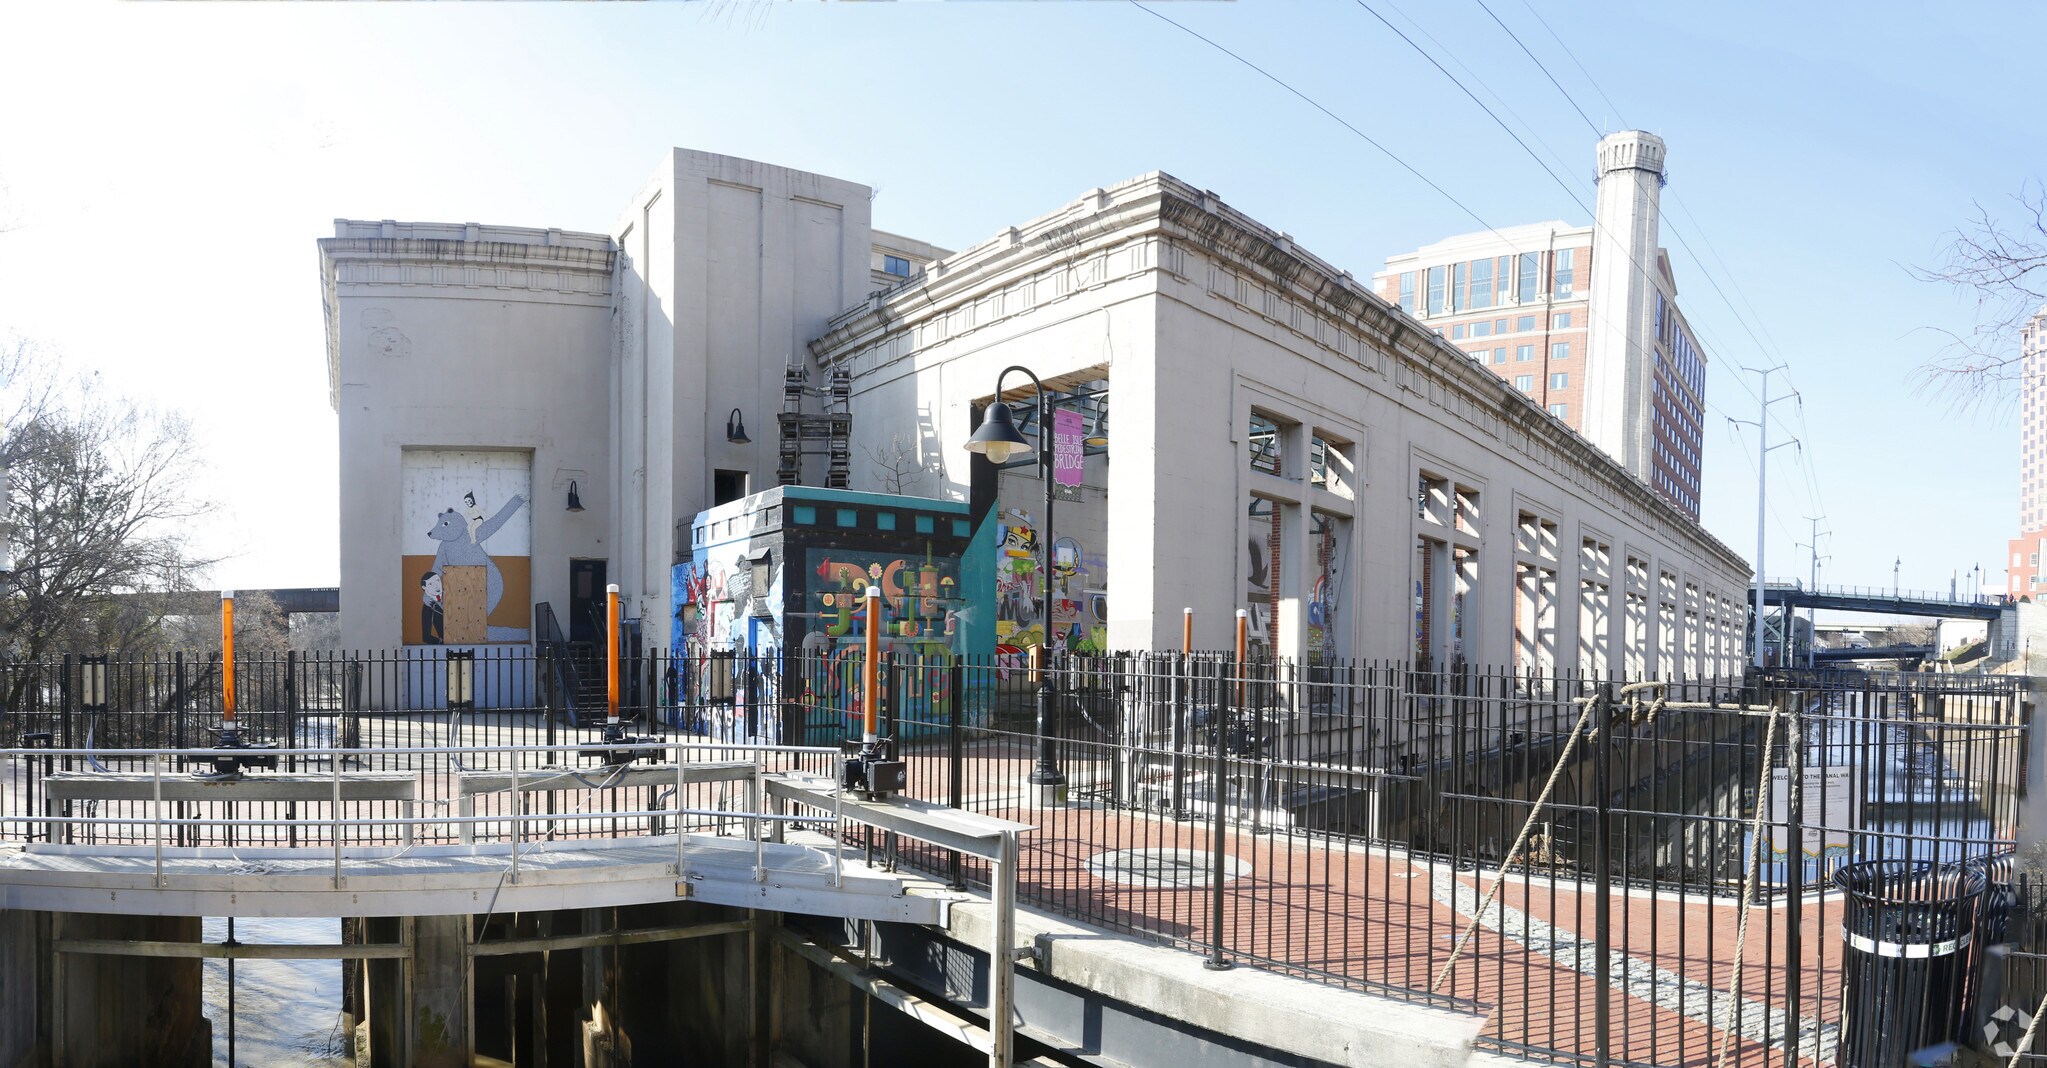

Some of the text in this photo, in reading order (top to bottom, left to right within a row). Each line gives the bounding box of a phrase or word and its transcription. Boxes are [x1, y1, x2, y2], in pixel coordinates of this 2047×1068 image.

[1054, 433, 1083, 445] BELLE ISLE
[1054, 444, 1084, 455] PEDESTRIAN
[1054, 453, 1084, 470] BRIDGE
